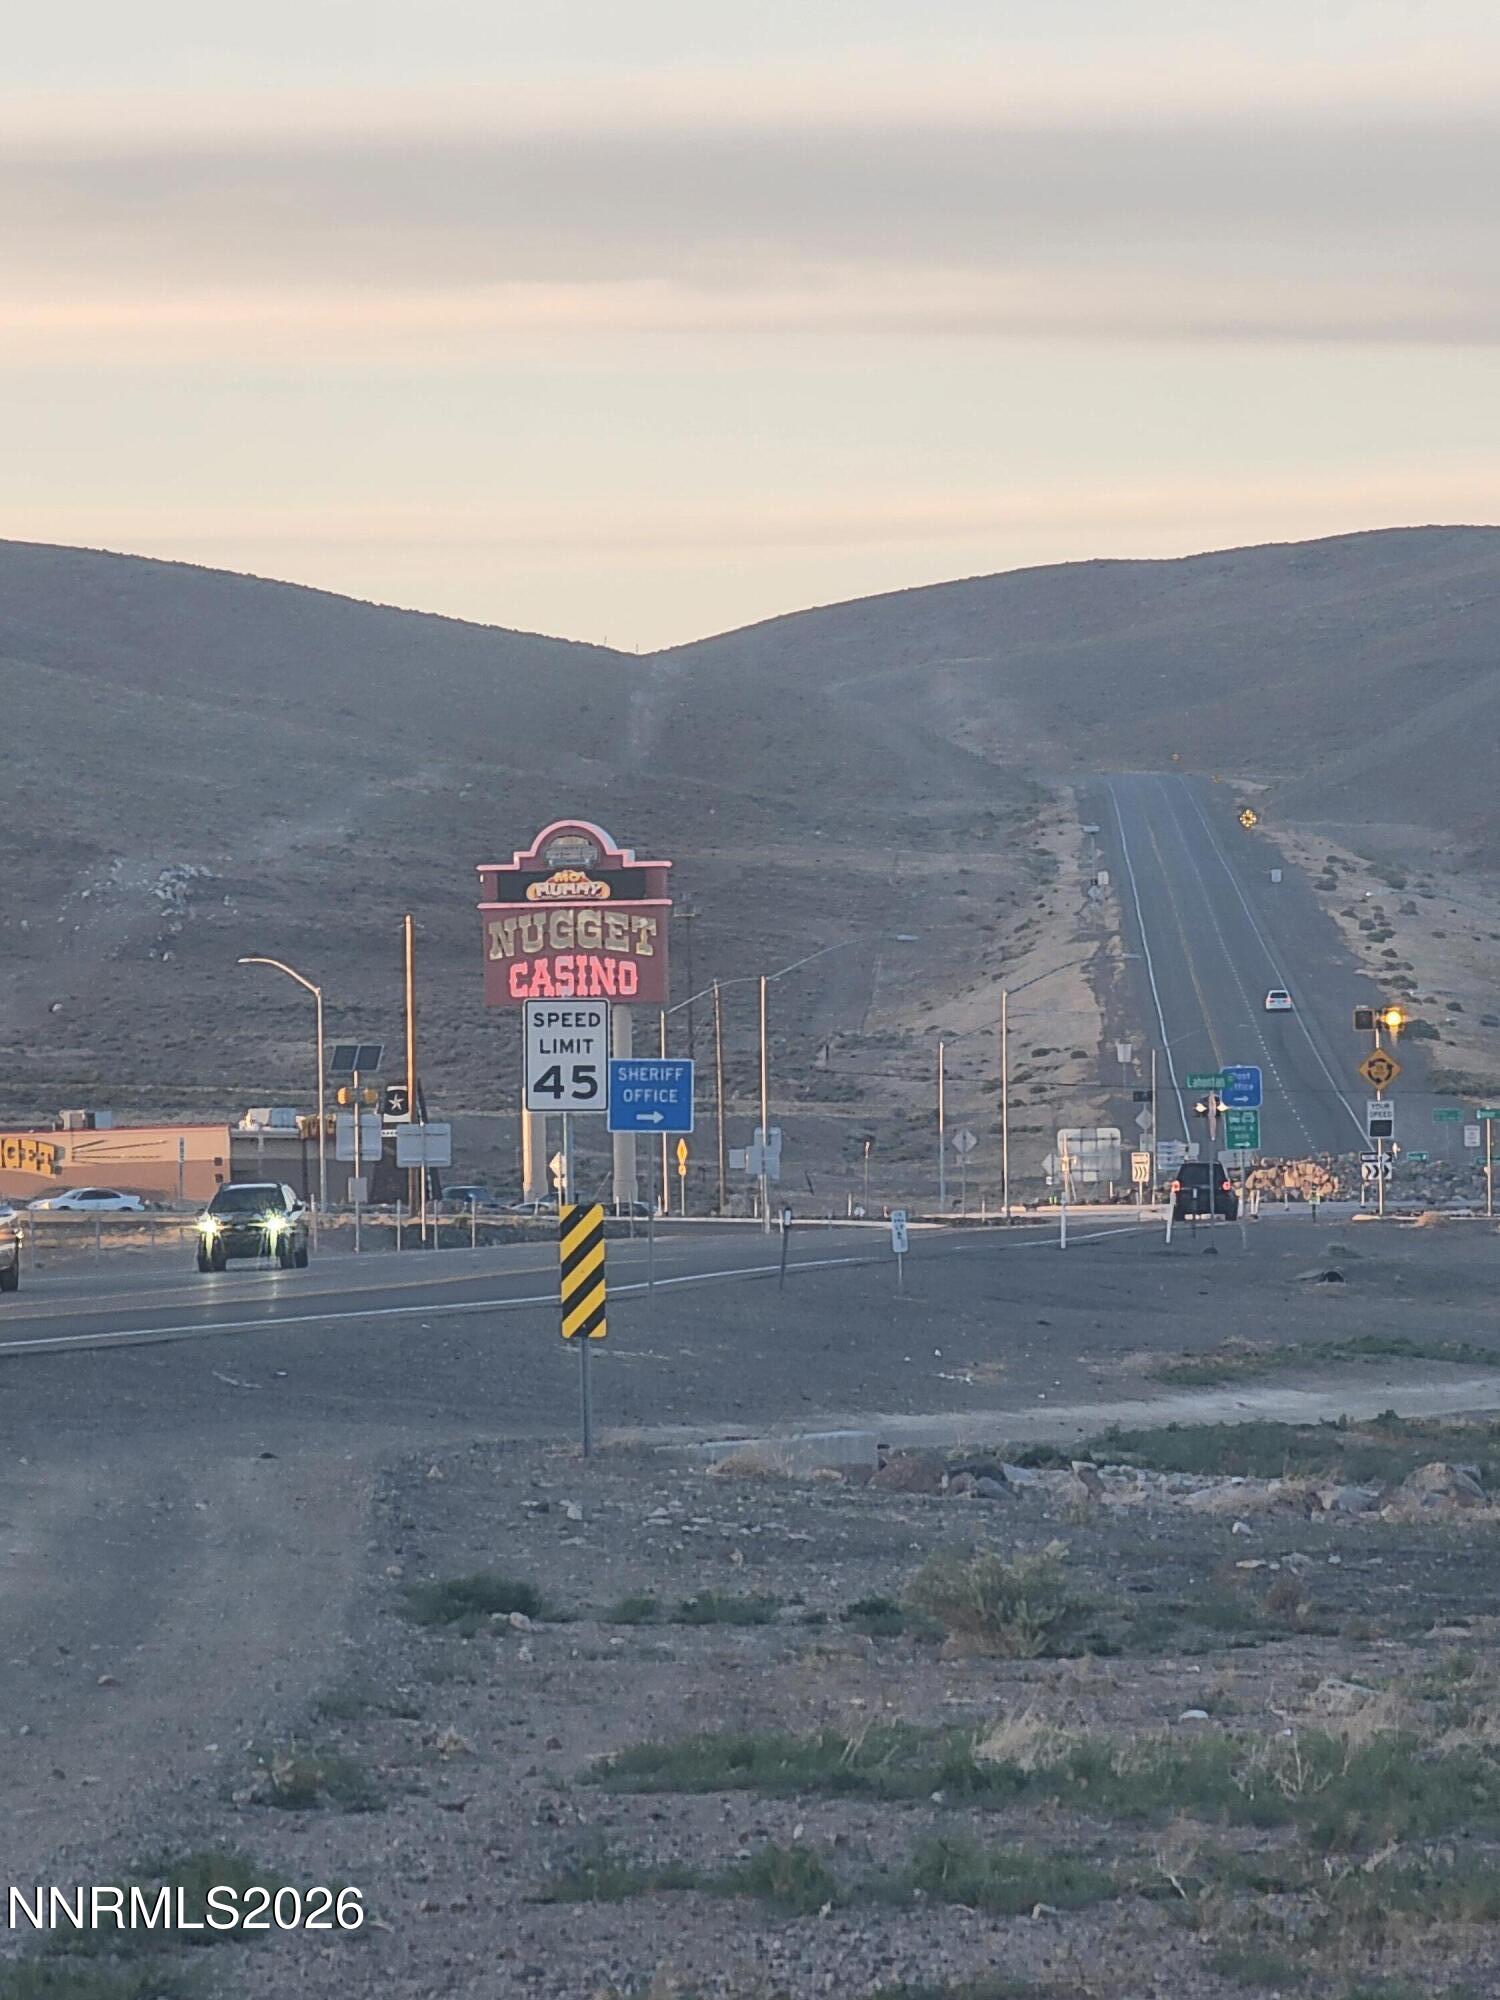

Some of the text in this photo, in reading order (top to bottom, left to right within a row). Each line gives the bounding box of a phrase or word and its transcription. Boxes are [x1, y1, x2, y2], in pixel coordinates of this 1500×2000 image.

[488, 909, 657, 960] NUGGET
[509, 954, 638, 998] CASINO
[533, 1012, 600, 1028] SPEED
[539, 1038, 594, 1054] LIMIT
[533, 1065, 598, 1099] 45
[618, 1067, 683, 1081] SHERIFF
[623, 1088, 678, 1103] OFFICE
[0, 1138, 56, 1178] GET
